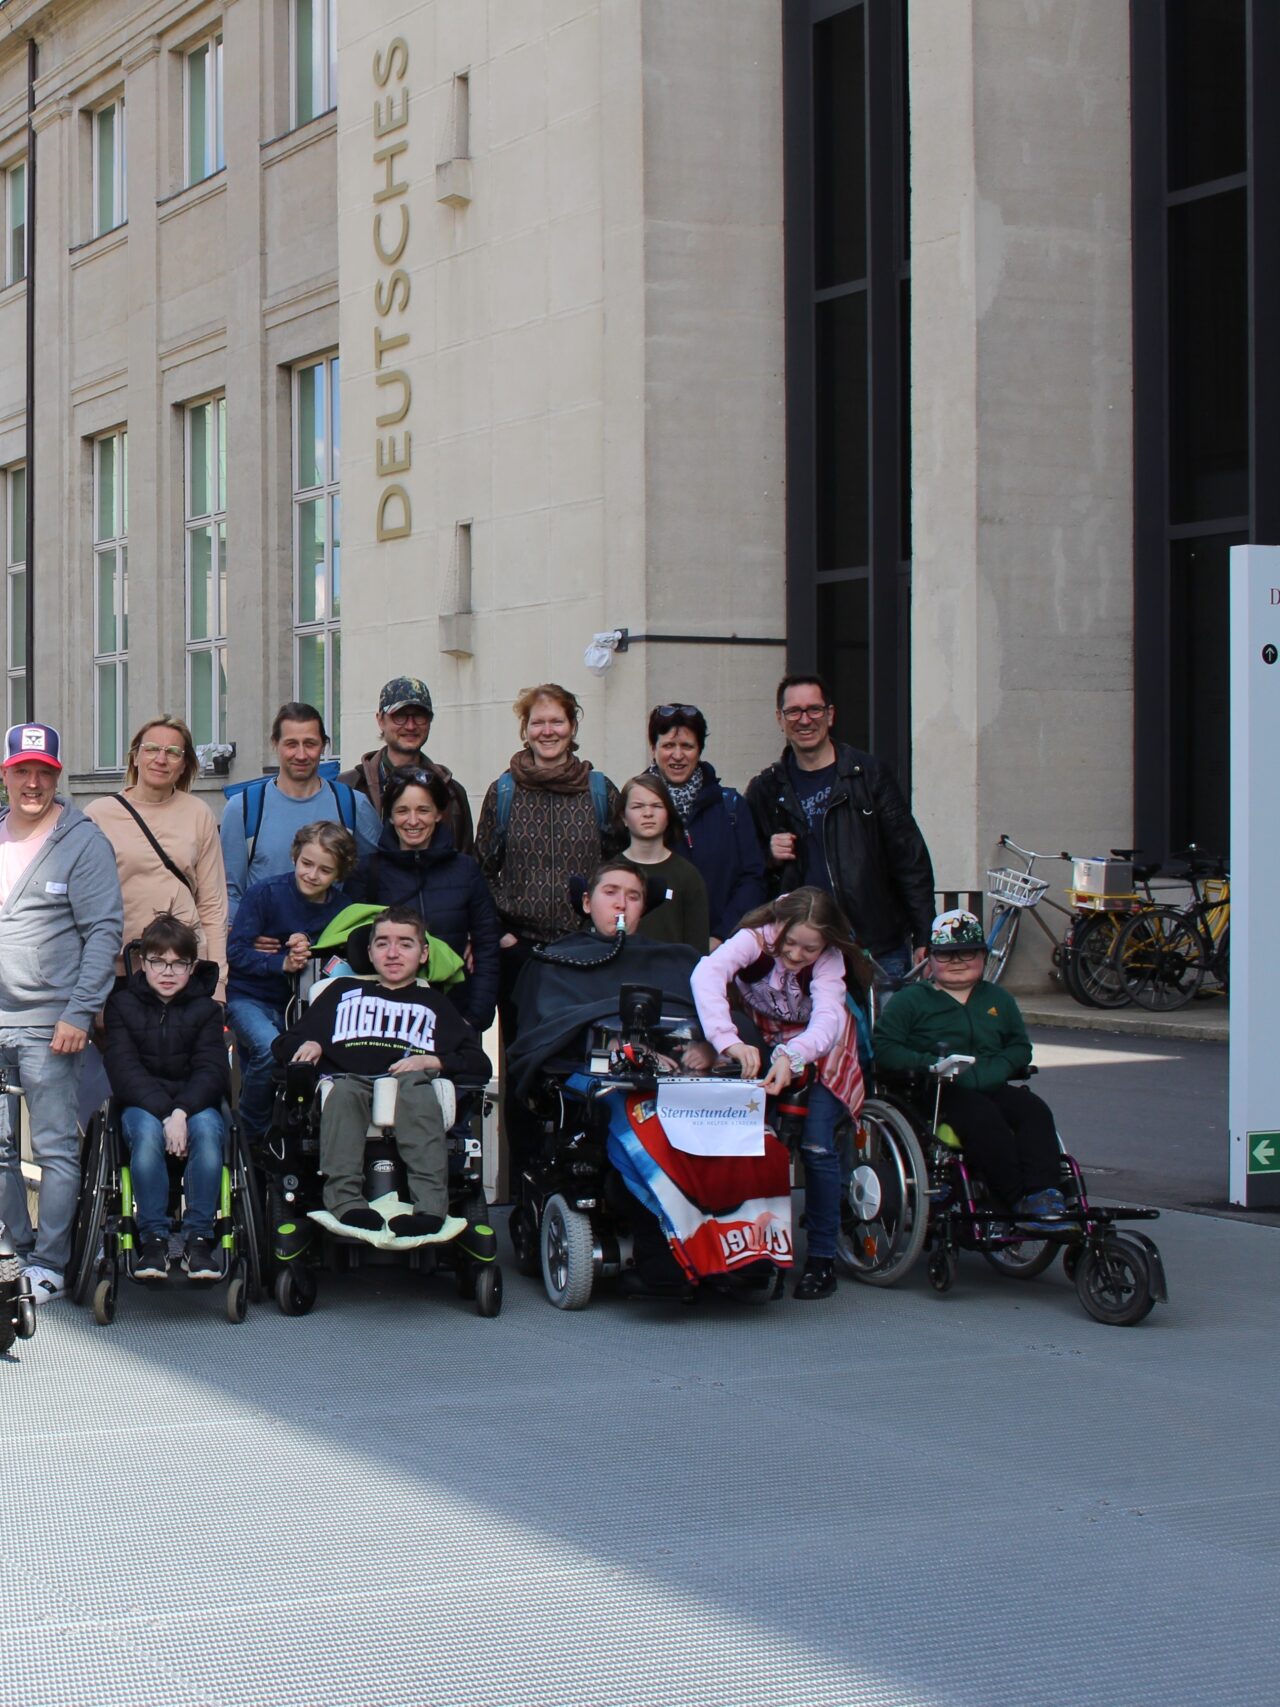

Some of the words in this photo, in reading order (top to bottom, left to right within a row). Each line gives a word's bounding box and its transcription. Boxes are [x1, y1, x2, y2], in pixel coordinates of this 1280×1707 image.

[372, 35, 412, 543] DEUTSCHES
[331, 995, 437, 1052] DIGITIZE
[660, 1106, 748, 1119] Sternstunden
